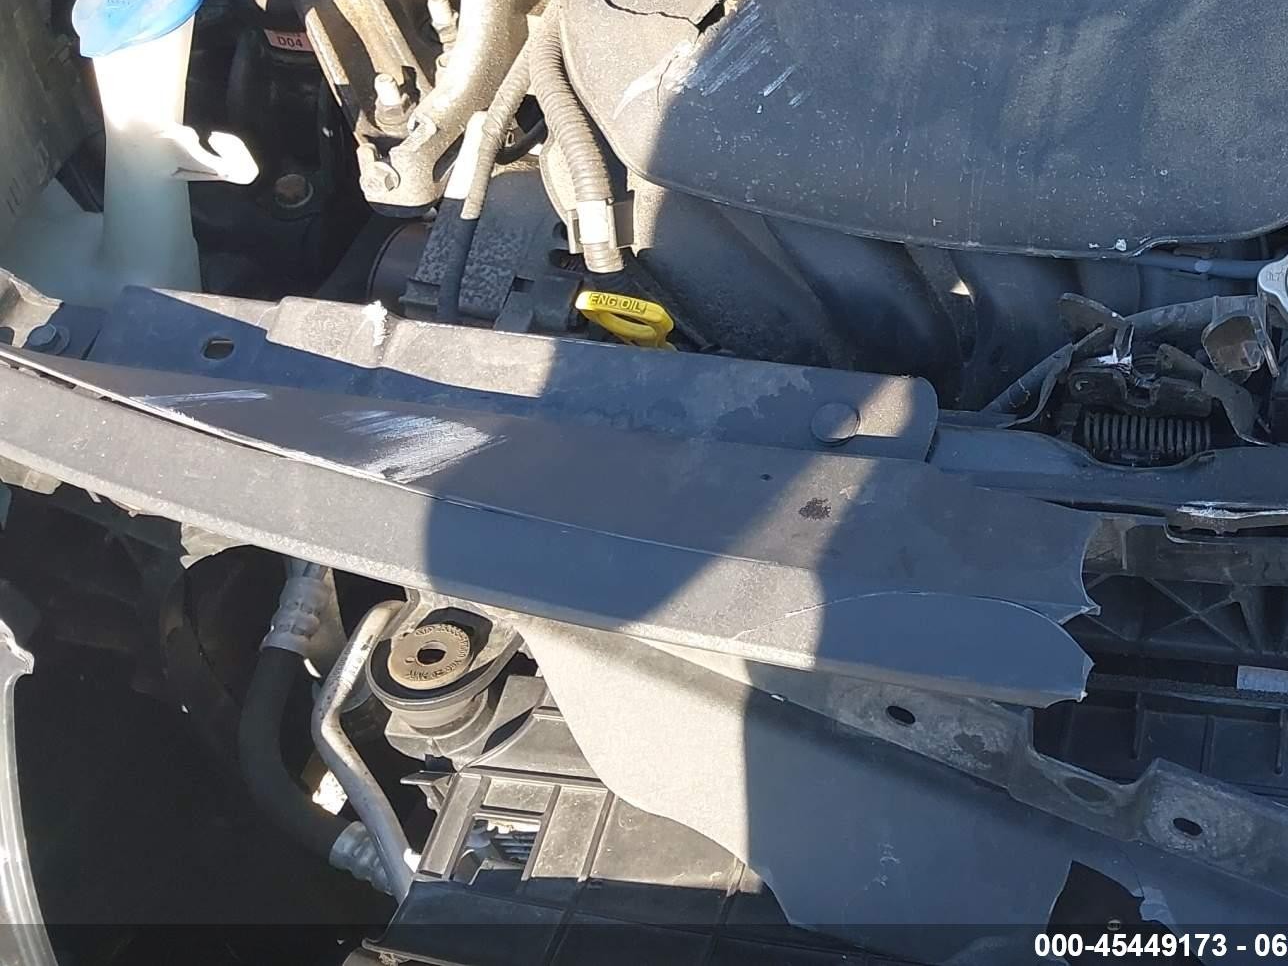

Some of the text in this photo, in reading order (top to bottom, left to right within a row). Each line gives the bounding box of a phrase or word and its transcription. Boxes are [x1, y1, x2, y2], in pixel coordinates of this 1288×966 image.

[277, 36, 303, 48] D04
[591, 293, 641, 313] ENG OIL
